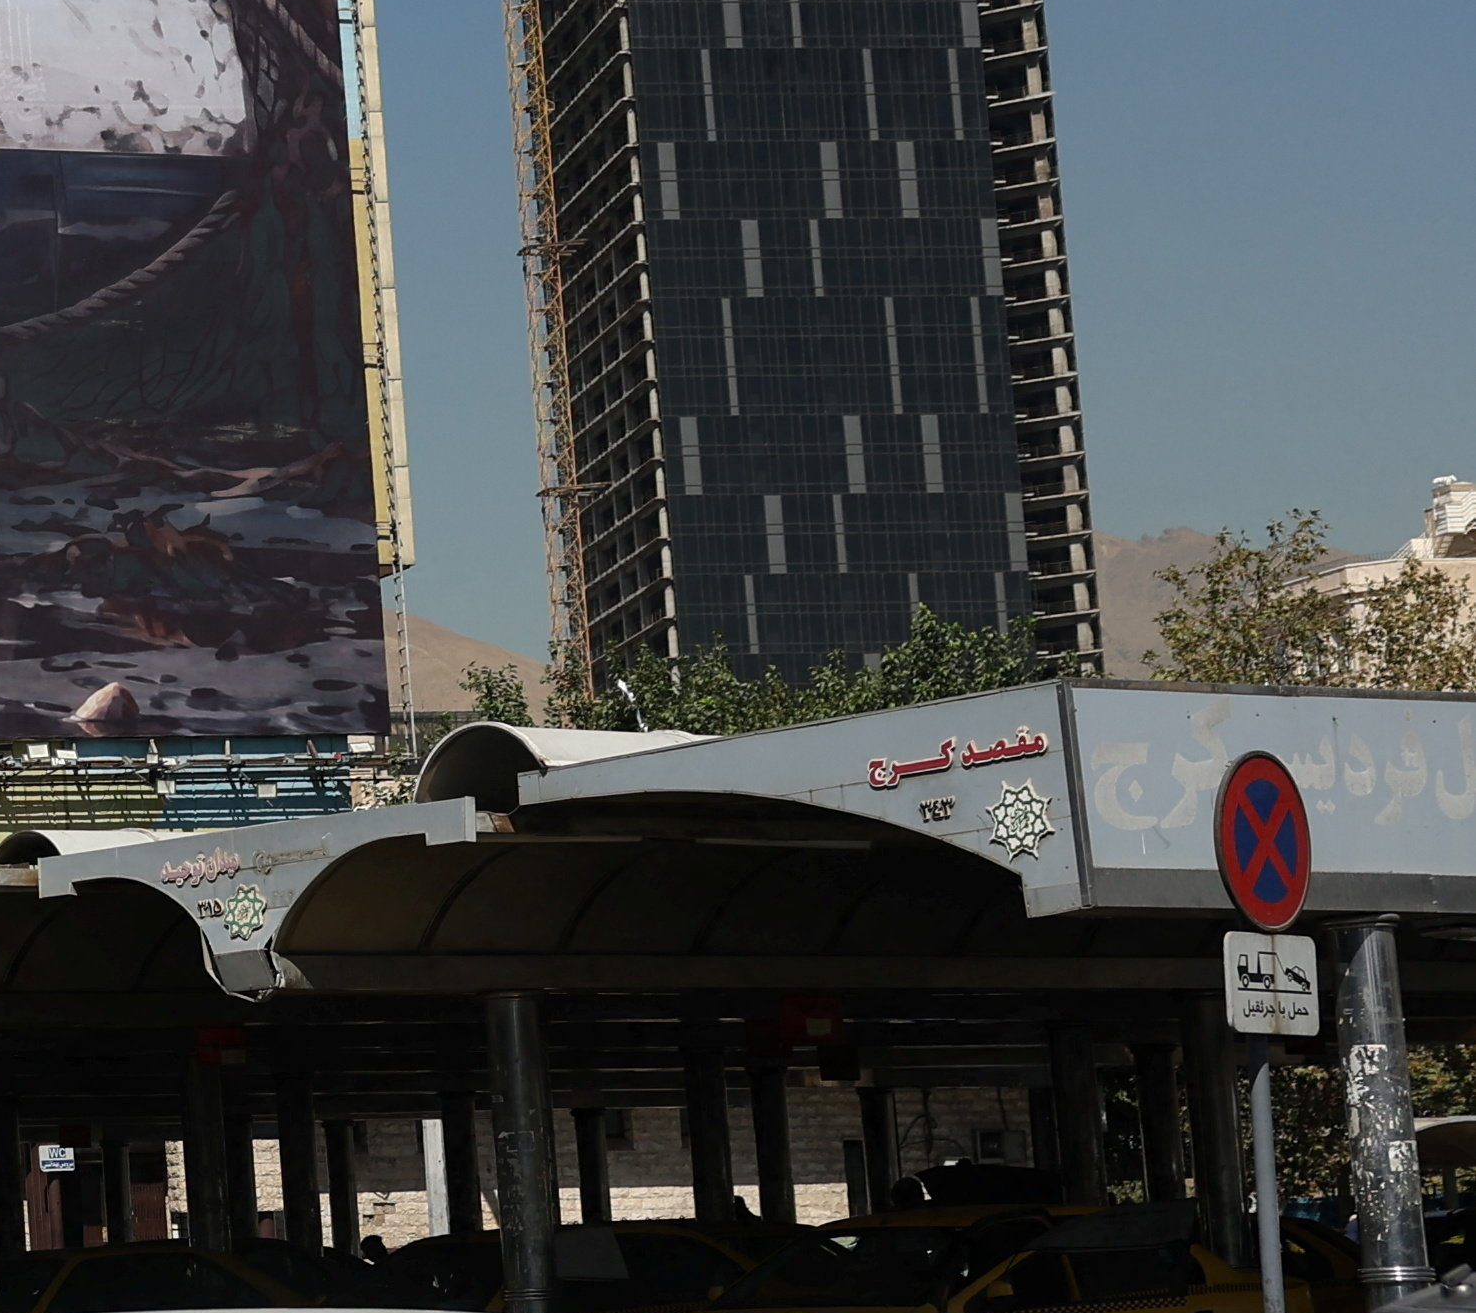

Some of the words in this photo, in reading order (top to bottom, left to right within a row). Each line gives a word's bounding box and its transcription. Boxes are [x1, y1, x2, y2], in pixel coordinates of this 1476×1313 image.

[960, 726, 1048, 767] مقصد
[867, 736, 957, 787] کرج
[1090, 696, 1231, 831] کرج
[160, 853, 206, 887] توحید
[197, 898, 224, 919] ۳۱۵
[1242, 999, 1276, 1019] جرثقیل
[1277, 1000, 1287, 1019] با
[1288, 1001, 1310, 1021] حمل
[48, 1147, 67, 1160] WC
